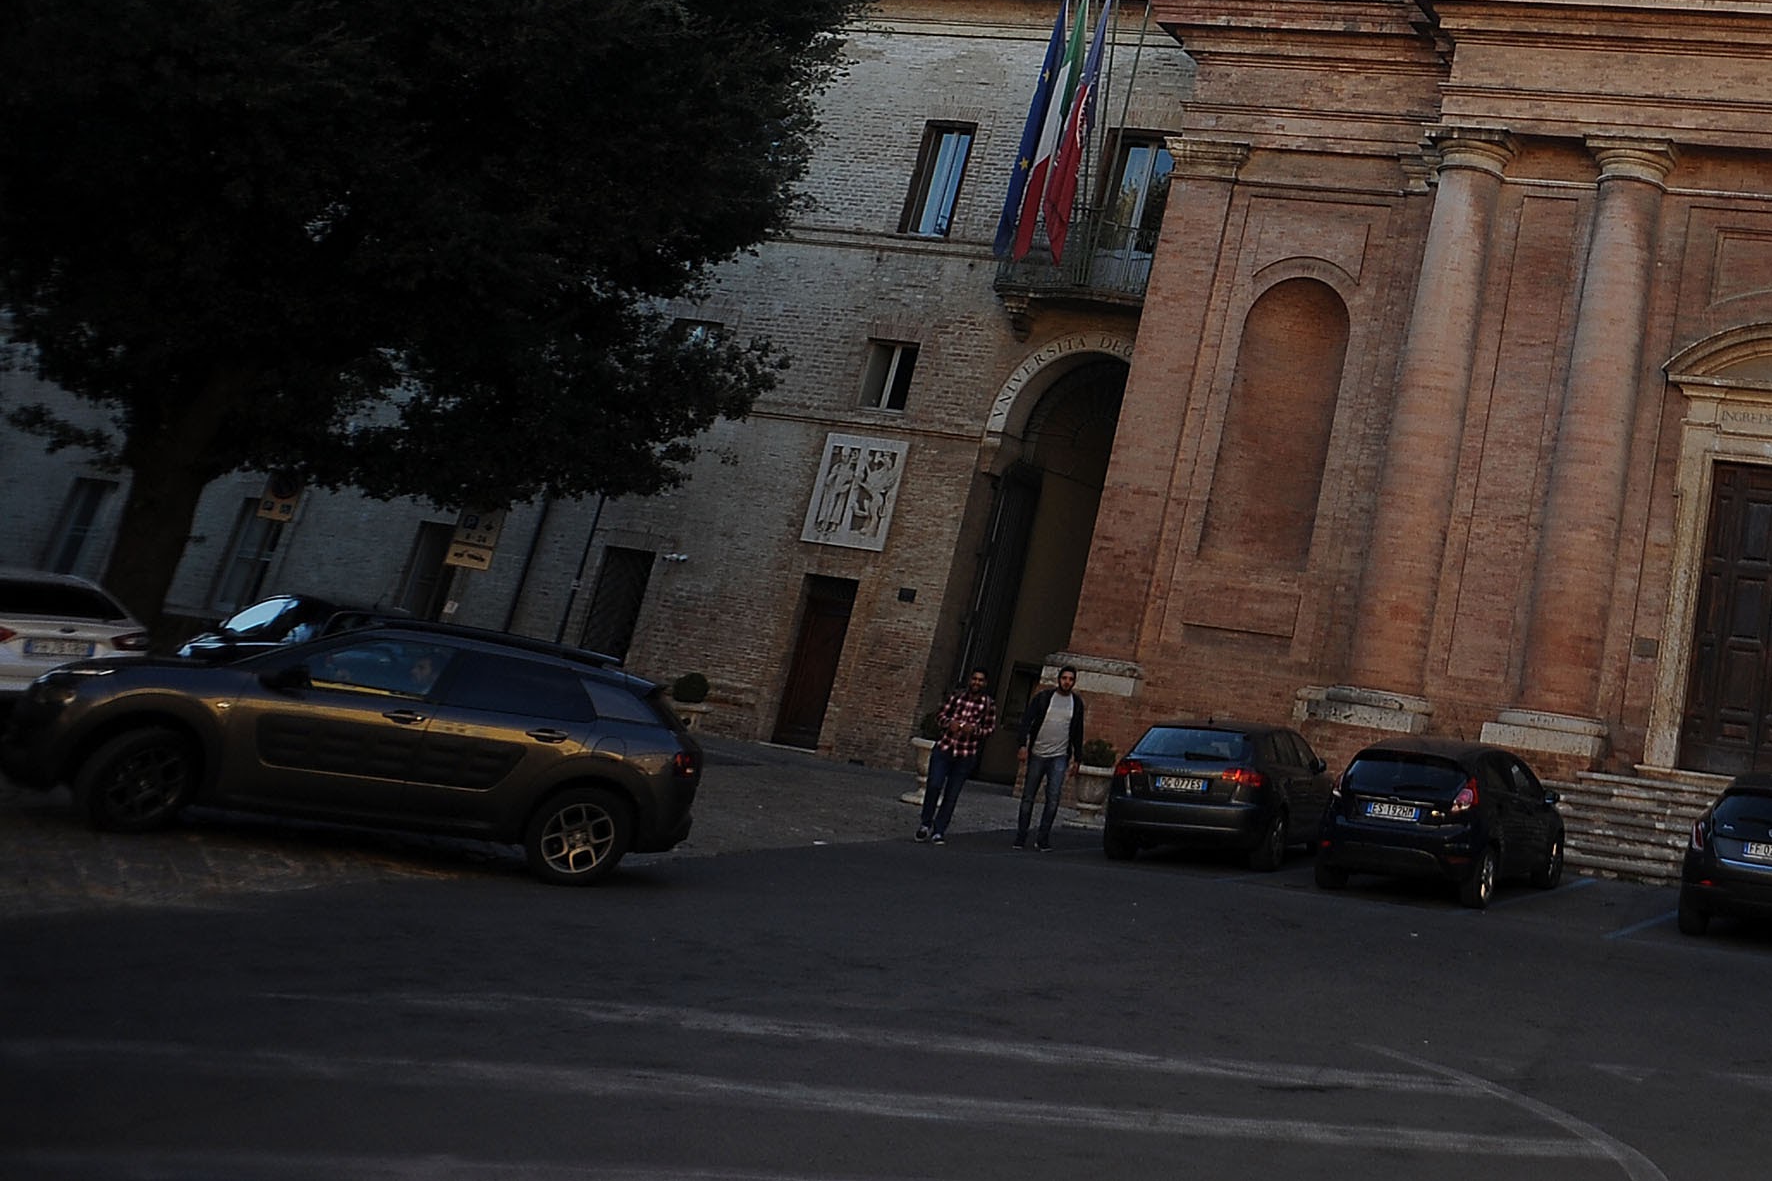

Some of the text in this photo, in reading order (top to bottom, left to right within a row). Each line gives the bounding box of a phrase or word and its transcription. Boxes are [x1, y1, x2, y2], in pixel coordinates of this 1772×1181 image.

[1174, 778, 1202, 789] 077ES
[1372, 802, 1384, 812] ES
[1749, 843, 1761, 853] FF
